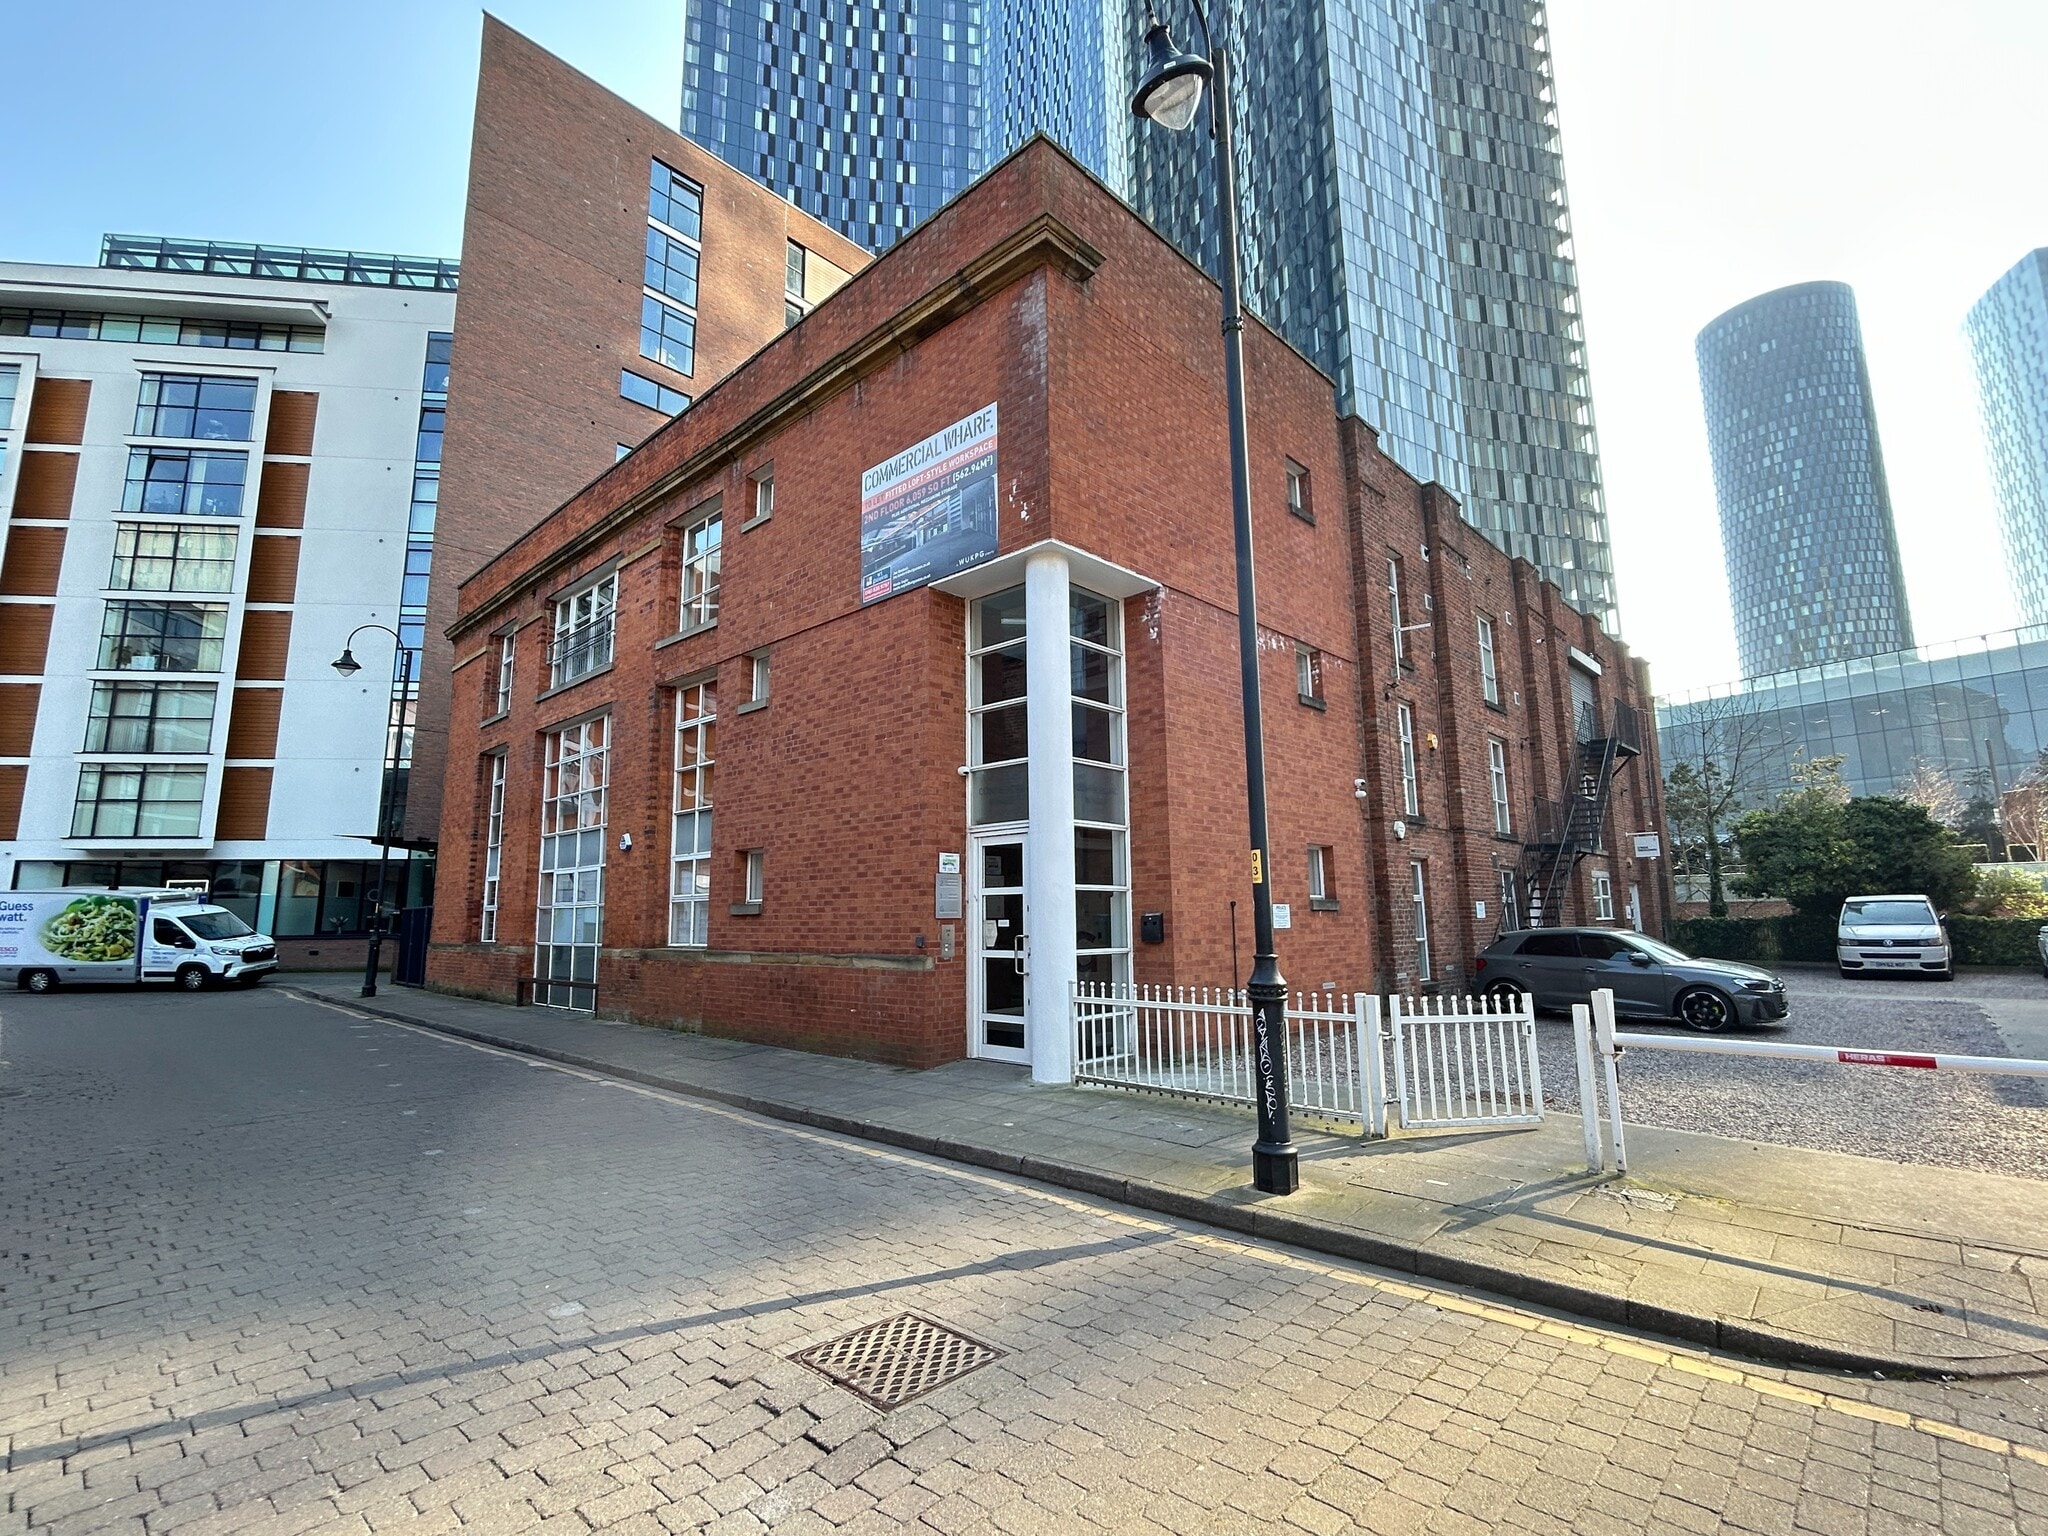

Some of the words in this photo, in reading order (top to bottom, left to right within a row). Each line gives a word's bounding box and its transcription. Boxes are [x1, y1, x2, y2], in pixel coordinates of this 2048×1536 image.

[864, 438, 942, 492] COMMERCIAL
[885, 484, 907, 500] FITTED
[908, 463, 948, 488] LOFT-STYLE
[948, 440, 993, 467] WORKSPACE
[863, 510, 879, 525] 2ND
[880, 497, 905, 517] FLOOR
[905, 487, 927, 504] 6,059
[927, 481, 939, 494] SQ
[940, 475, 951, 488] FT
[0, 900, 34, 911] Guess
[1844, 1053, 1885, 1062] HERAS
